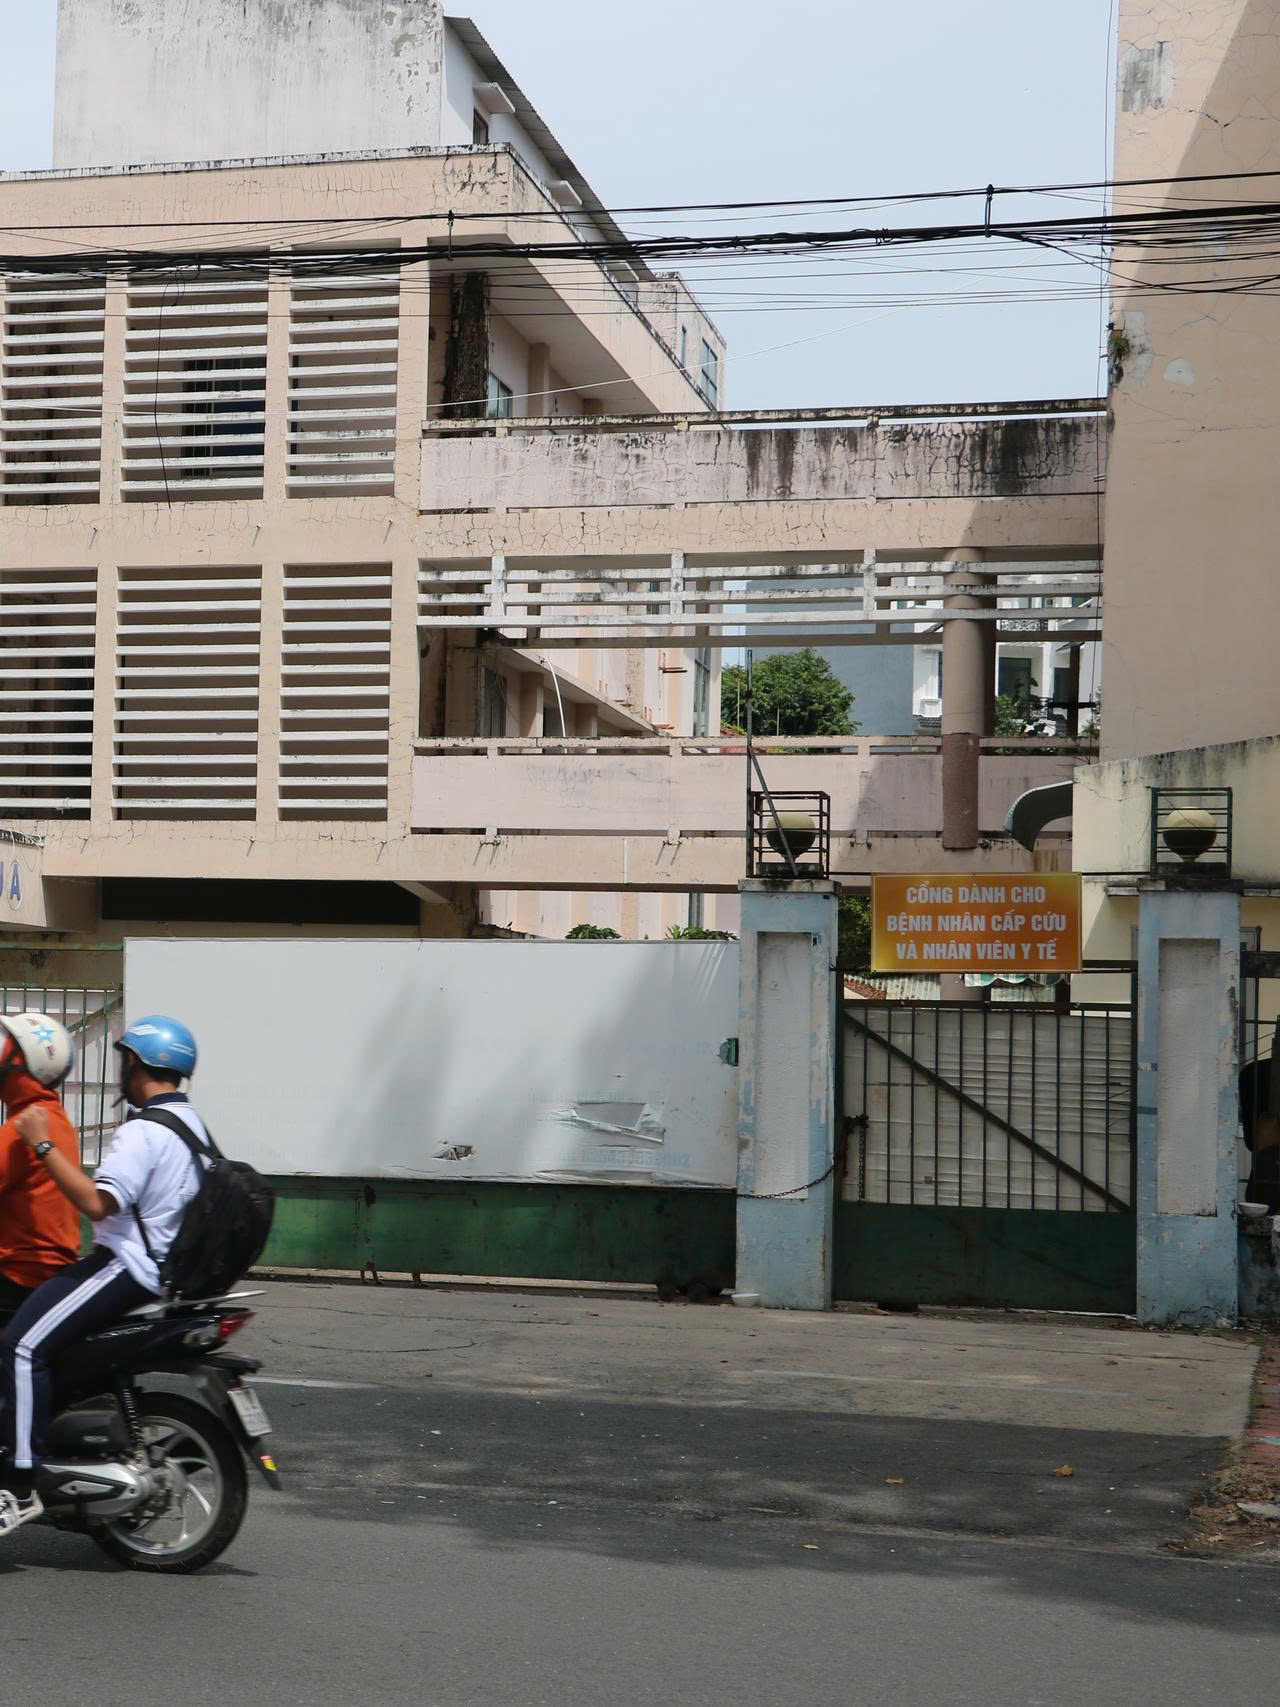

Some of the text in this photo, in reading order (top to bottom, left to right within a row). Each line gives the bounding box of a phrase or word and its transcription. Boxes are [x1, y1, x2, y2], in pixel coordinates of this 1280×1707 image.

[905, 880, 1046, 904] CỔNG DÀNH CHO
[886, 909, 1066, 935] BỆNH NHÂN CẤP CỨU
[896, 938, 1057, 960] VÀ NHÂN VIÊN Y TẾ
